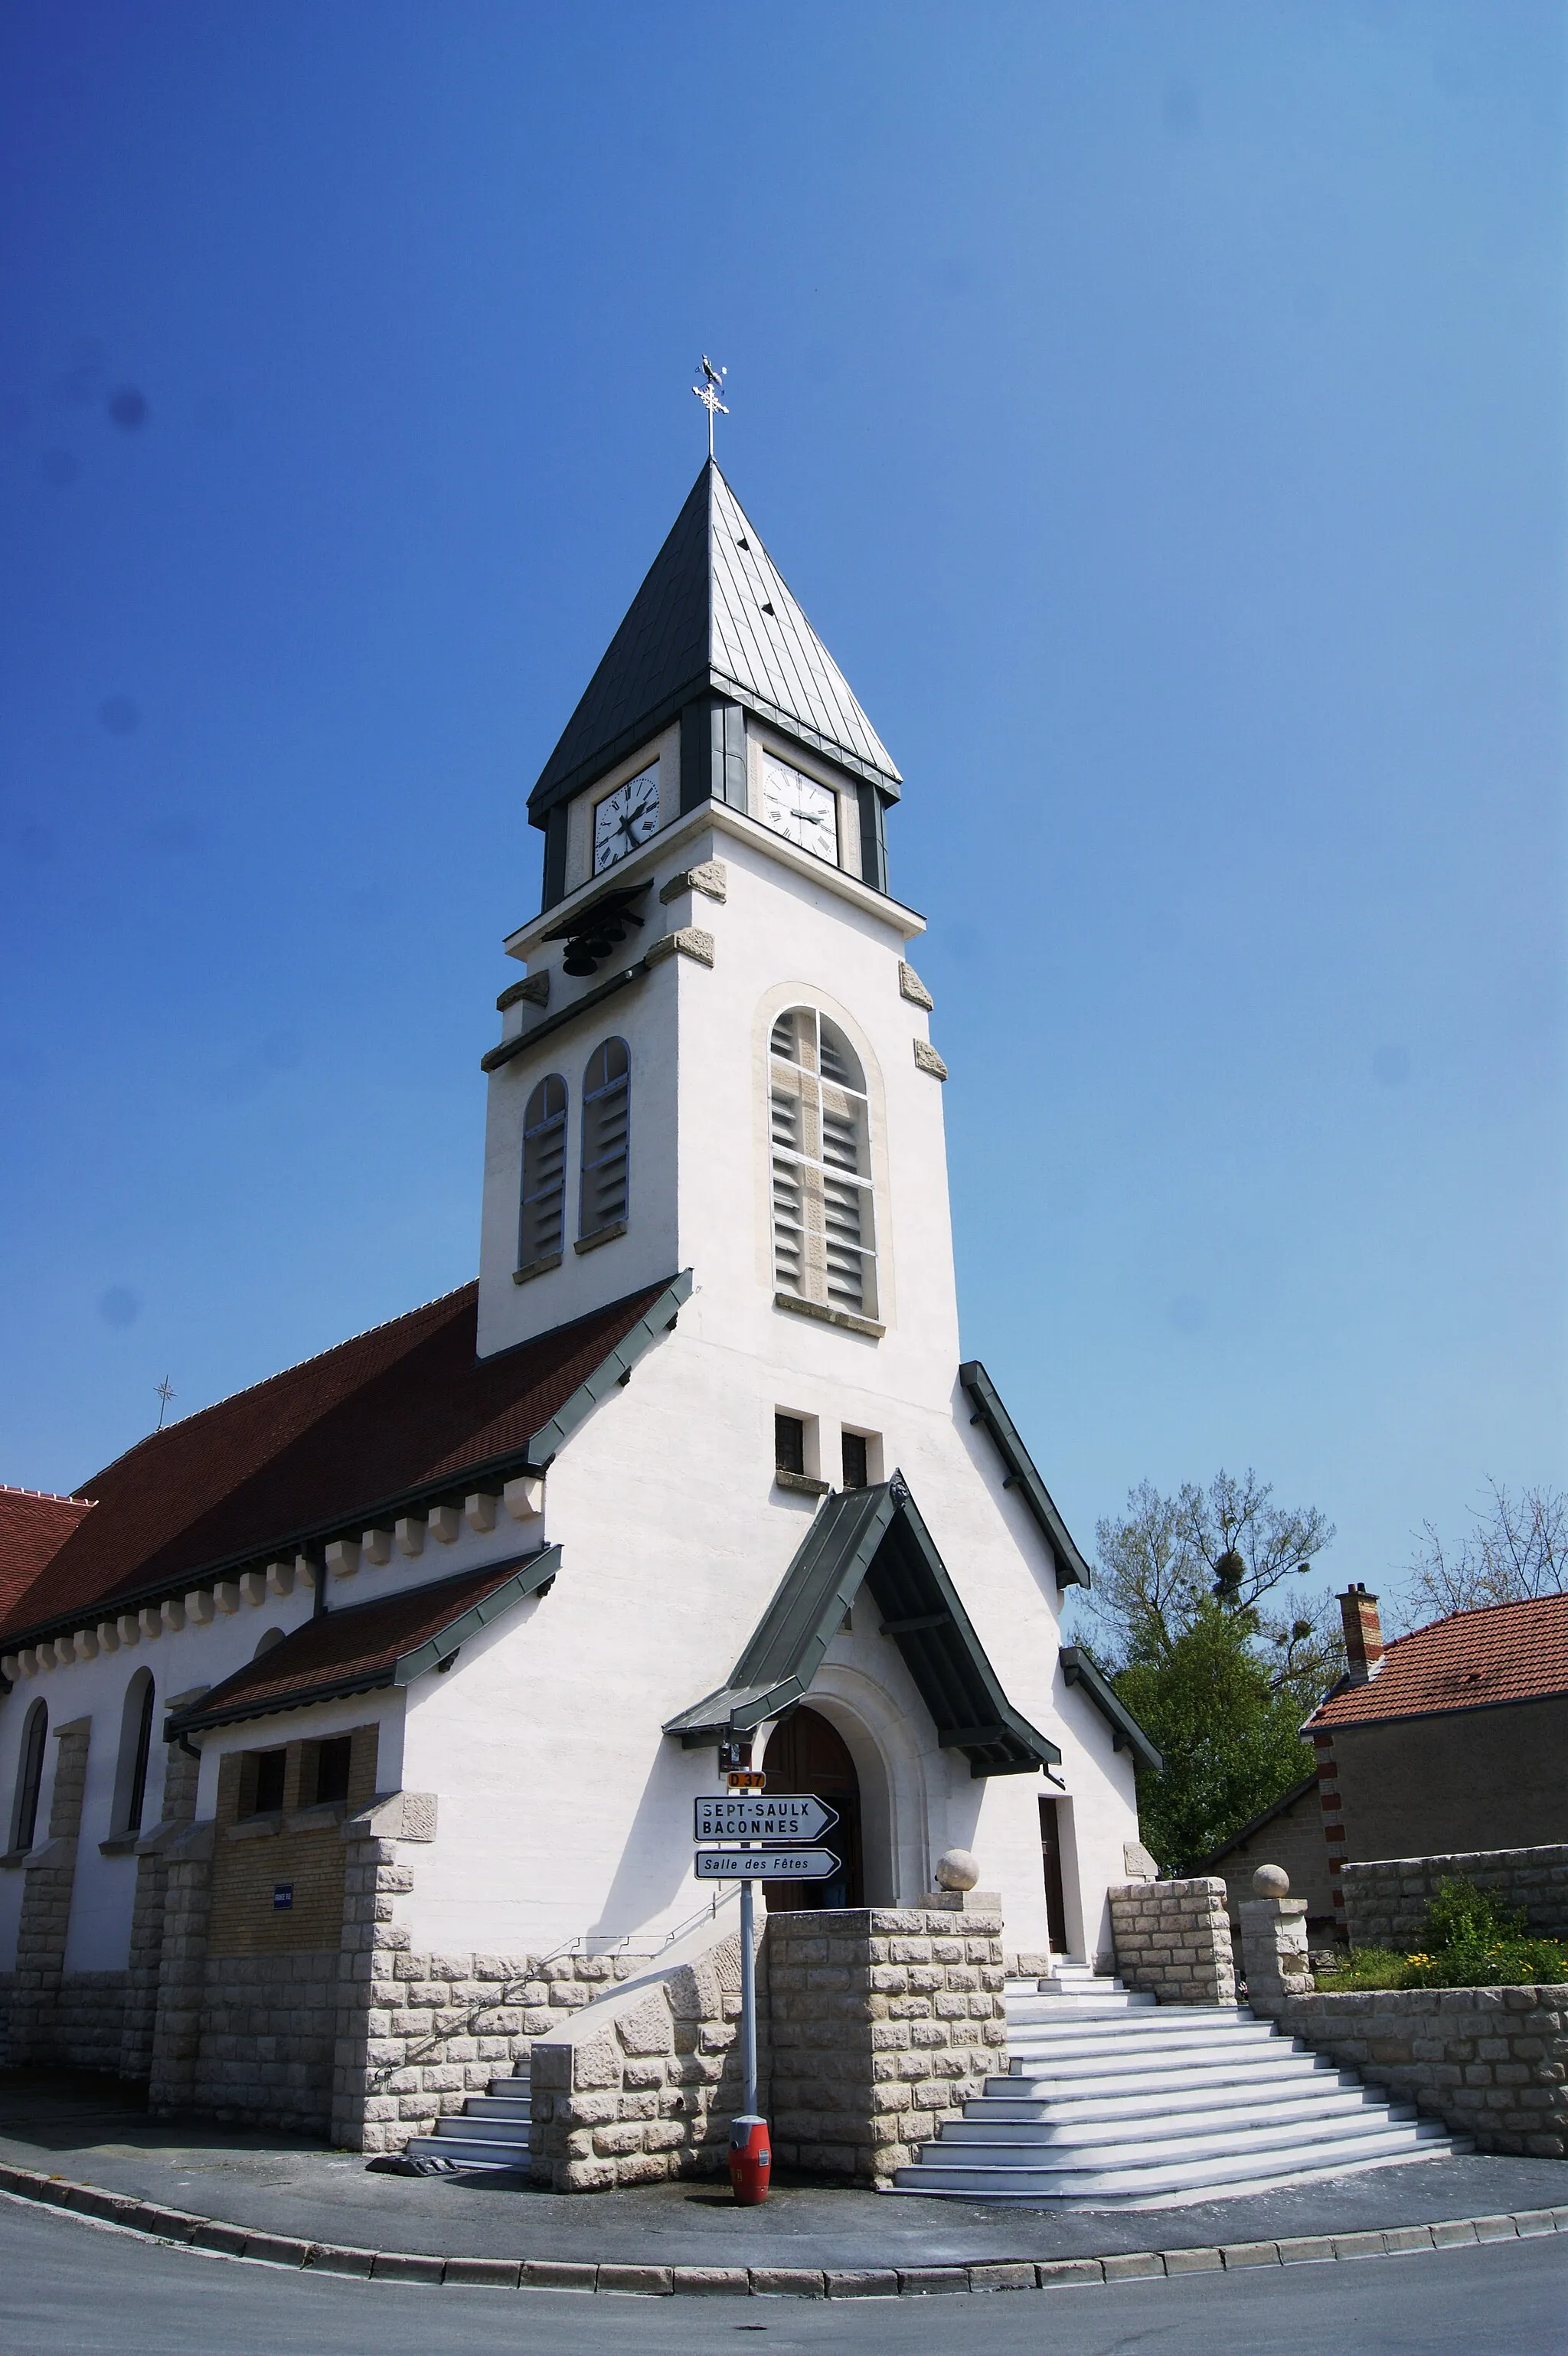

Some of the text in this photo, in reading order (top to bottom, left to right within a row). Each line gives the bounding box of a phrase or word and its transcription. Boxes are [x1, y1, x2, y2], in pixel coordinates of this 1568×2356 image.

[730, 1774, 763, 1787] D 37
[703, 1803, 809, 1817] SEPT-SAULX
[703, 1820, 799, 1834] BACONNES
[704, 1858, 808, 1870] Salle des Fêtes
